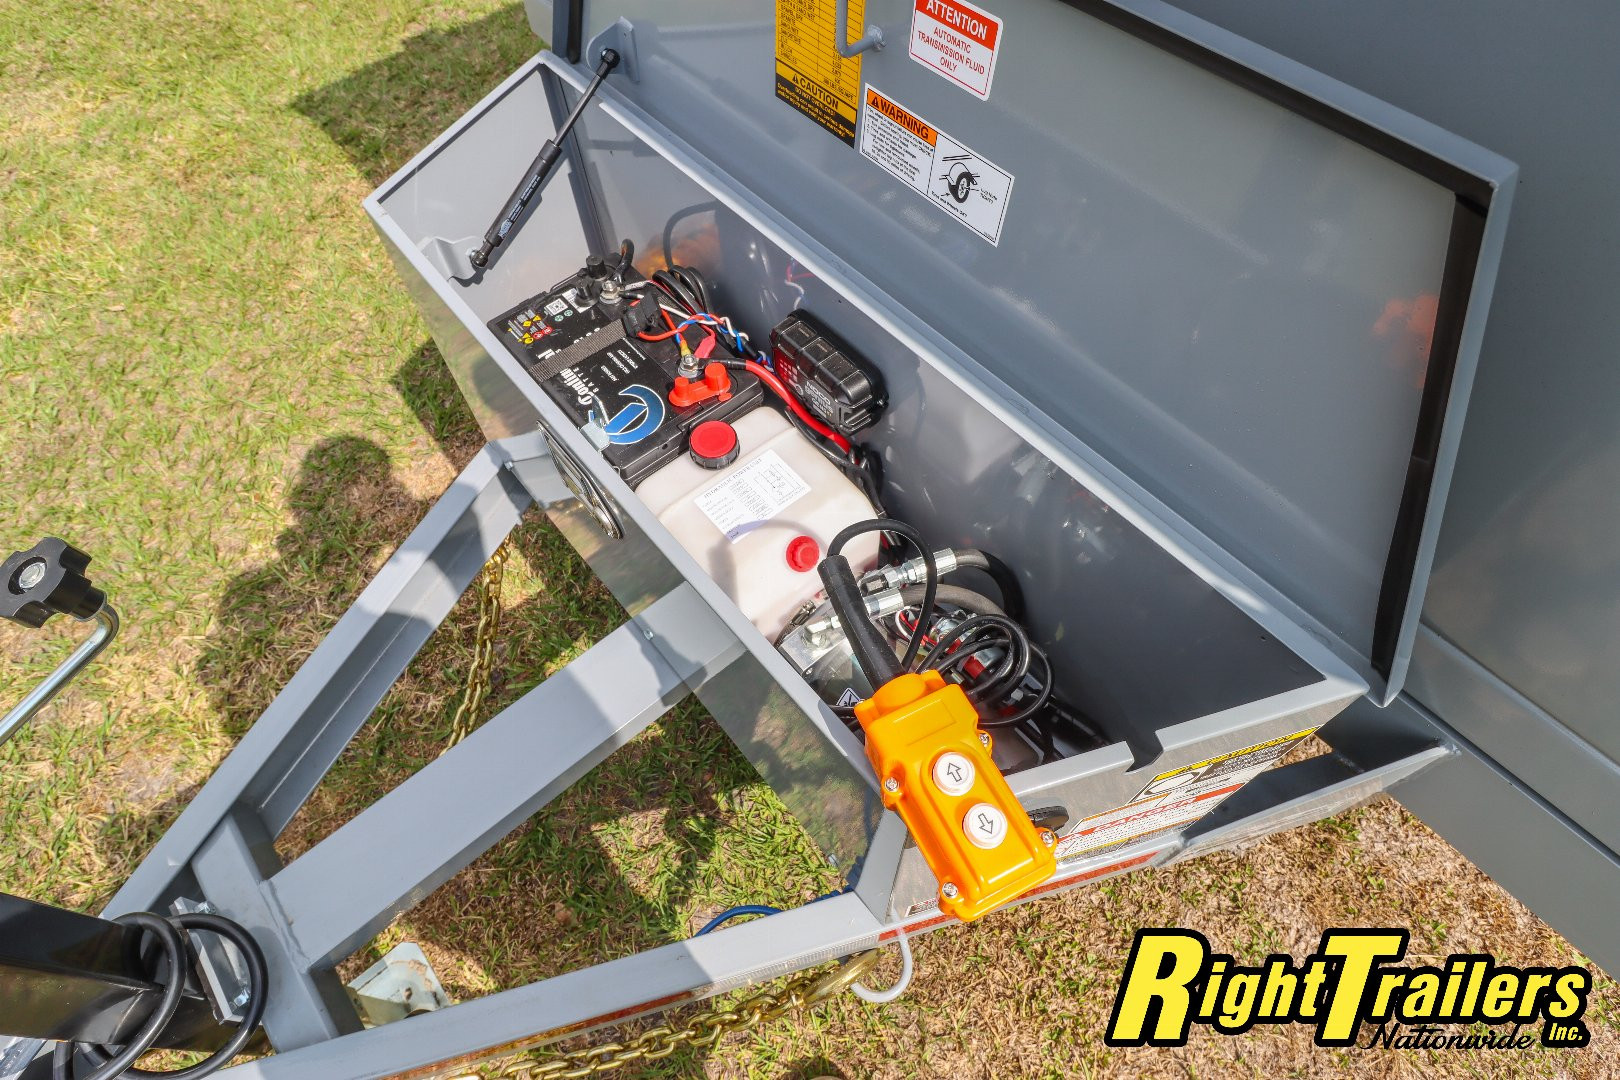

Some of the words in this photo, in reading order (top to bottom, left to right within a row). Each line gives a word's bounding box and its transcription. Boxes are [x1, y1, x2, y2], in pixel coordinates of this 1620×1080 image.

[926, 0, 987, 40] ATTENTION
[934, 27, 971, 53] AUTOMATIC
[918, 30, 965, 63] TRANSMISSION
[966, 58, 985, 74] FLUID
[940, 56, 957, 72] ONLY
[800, 76, 839, 110] CAUTION
[880, 99, 929, 140] WARNING
[538, 348, 593, 405] Continal
[555, 348, 600, 393] BATTES
